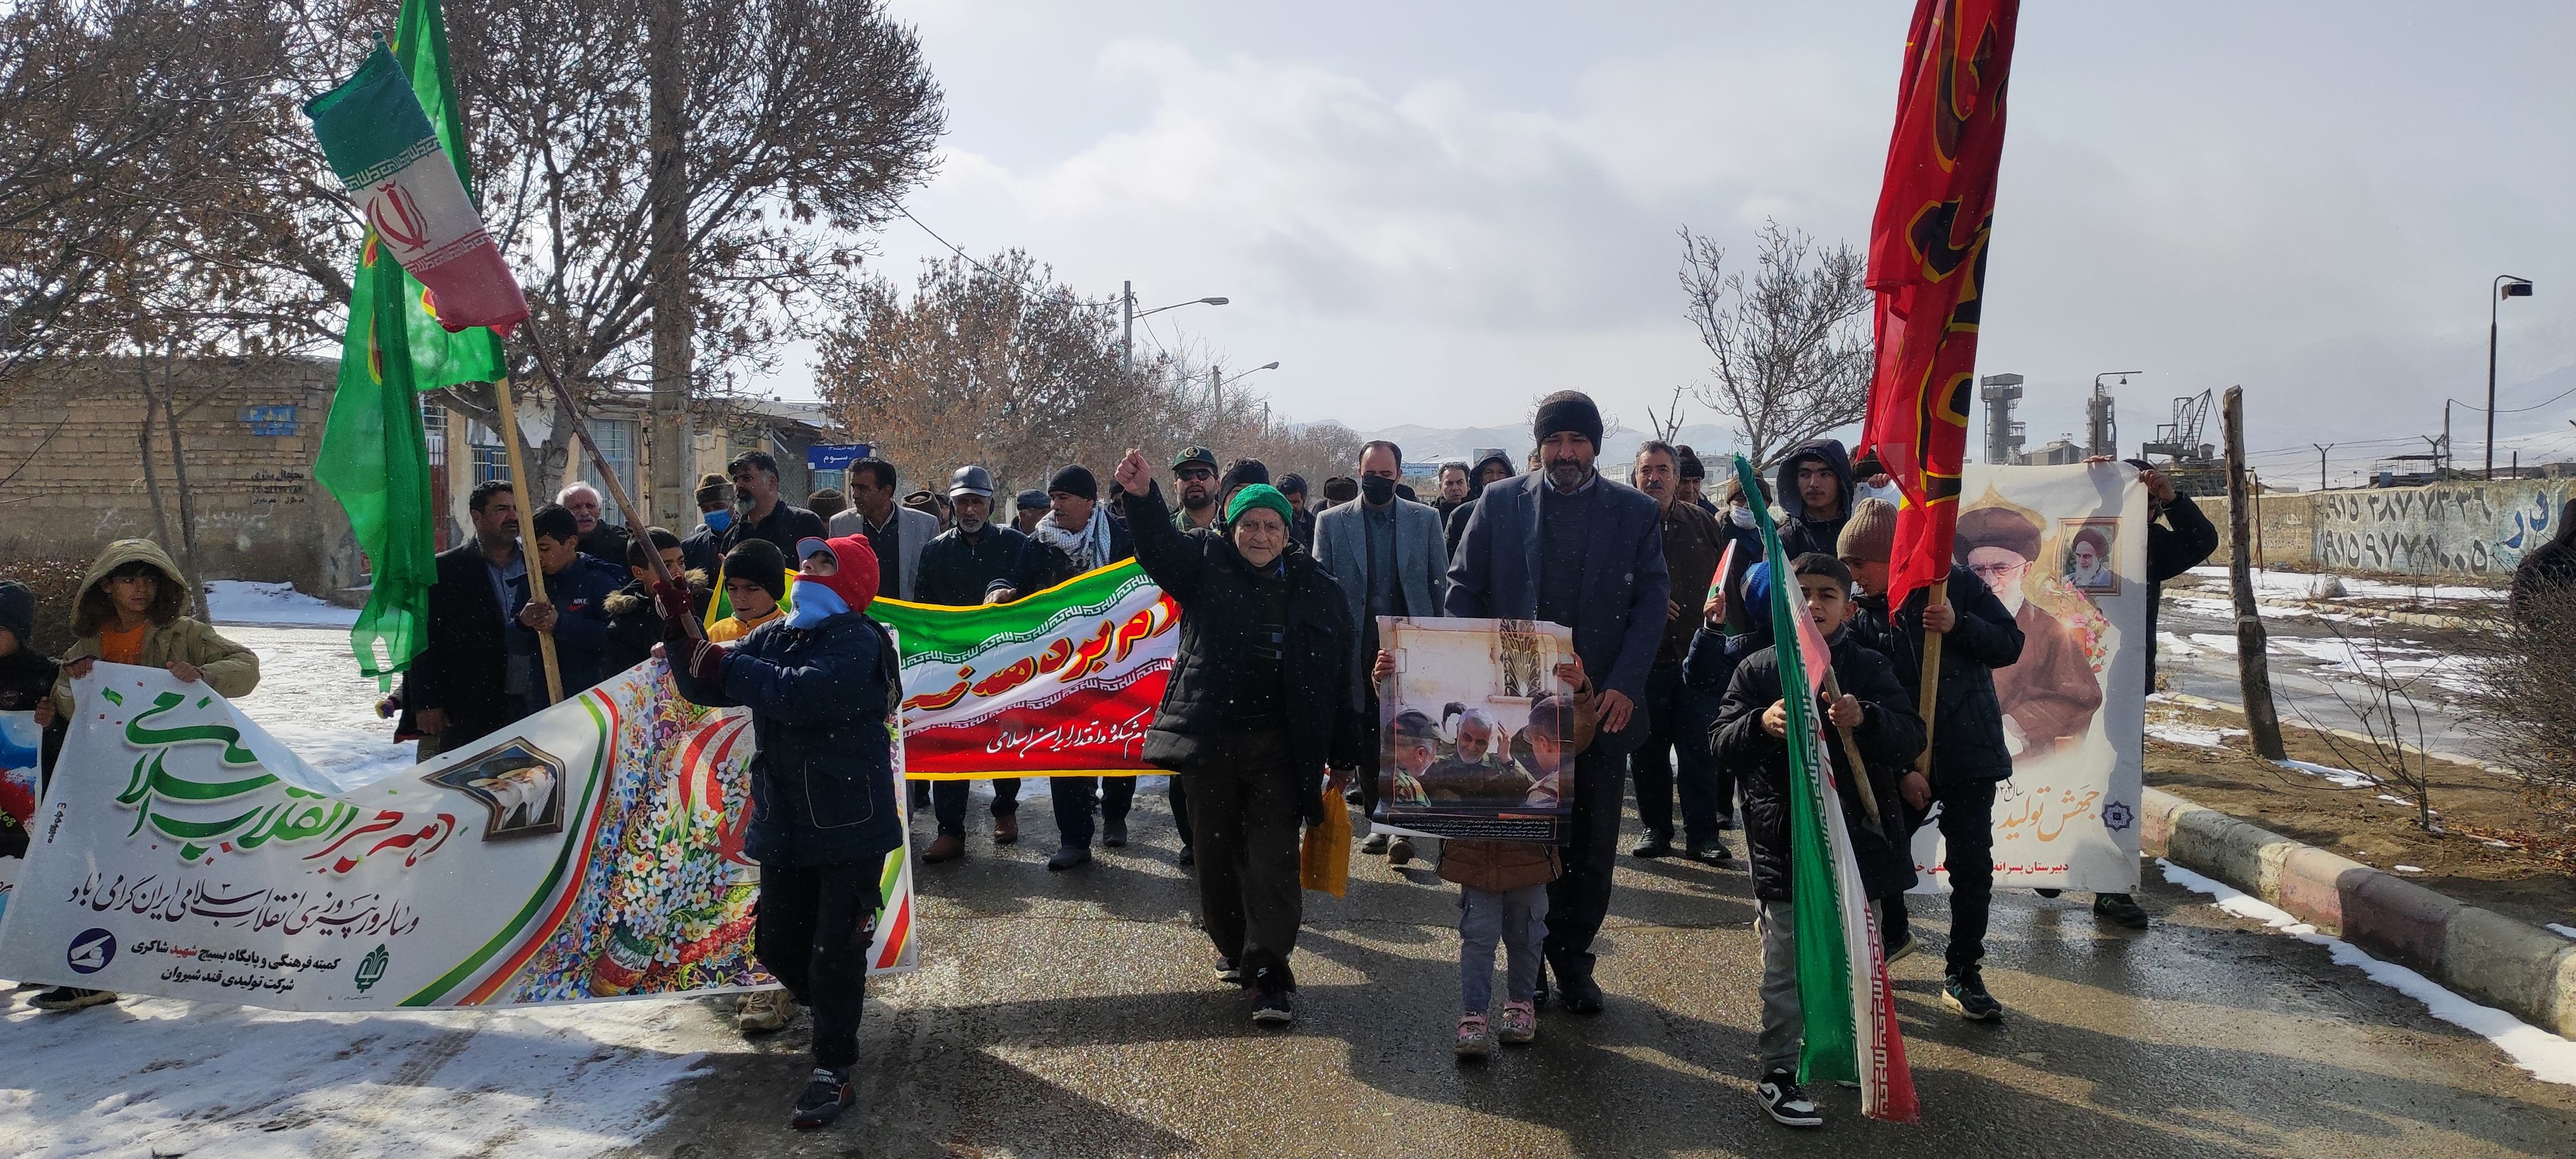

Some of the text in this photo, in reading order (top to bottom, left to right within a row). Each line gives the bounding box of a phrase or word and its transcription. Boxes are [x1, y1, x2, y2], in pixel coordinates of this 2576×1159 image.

[823, 455, 848, 463] سوم
[1997, 786, 2051, 840] تولید
[2037, 784, 2100, 841] جهش
[1994, 861, 2069, 875] دبیرستان پسرانه
[130, 940, 341, 972] کمیته فرهنگی و پایگاه بسیج شهید شاکری
[160, 966, 295, 994] شرکت تولیدی قند شیروان
